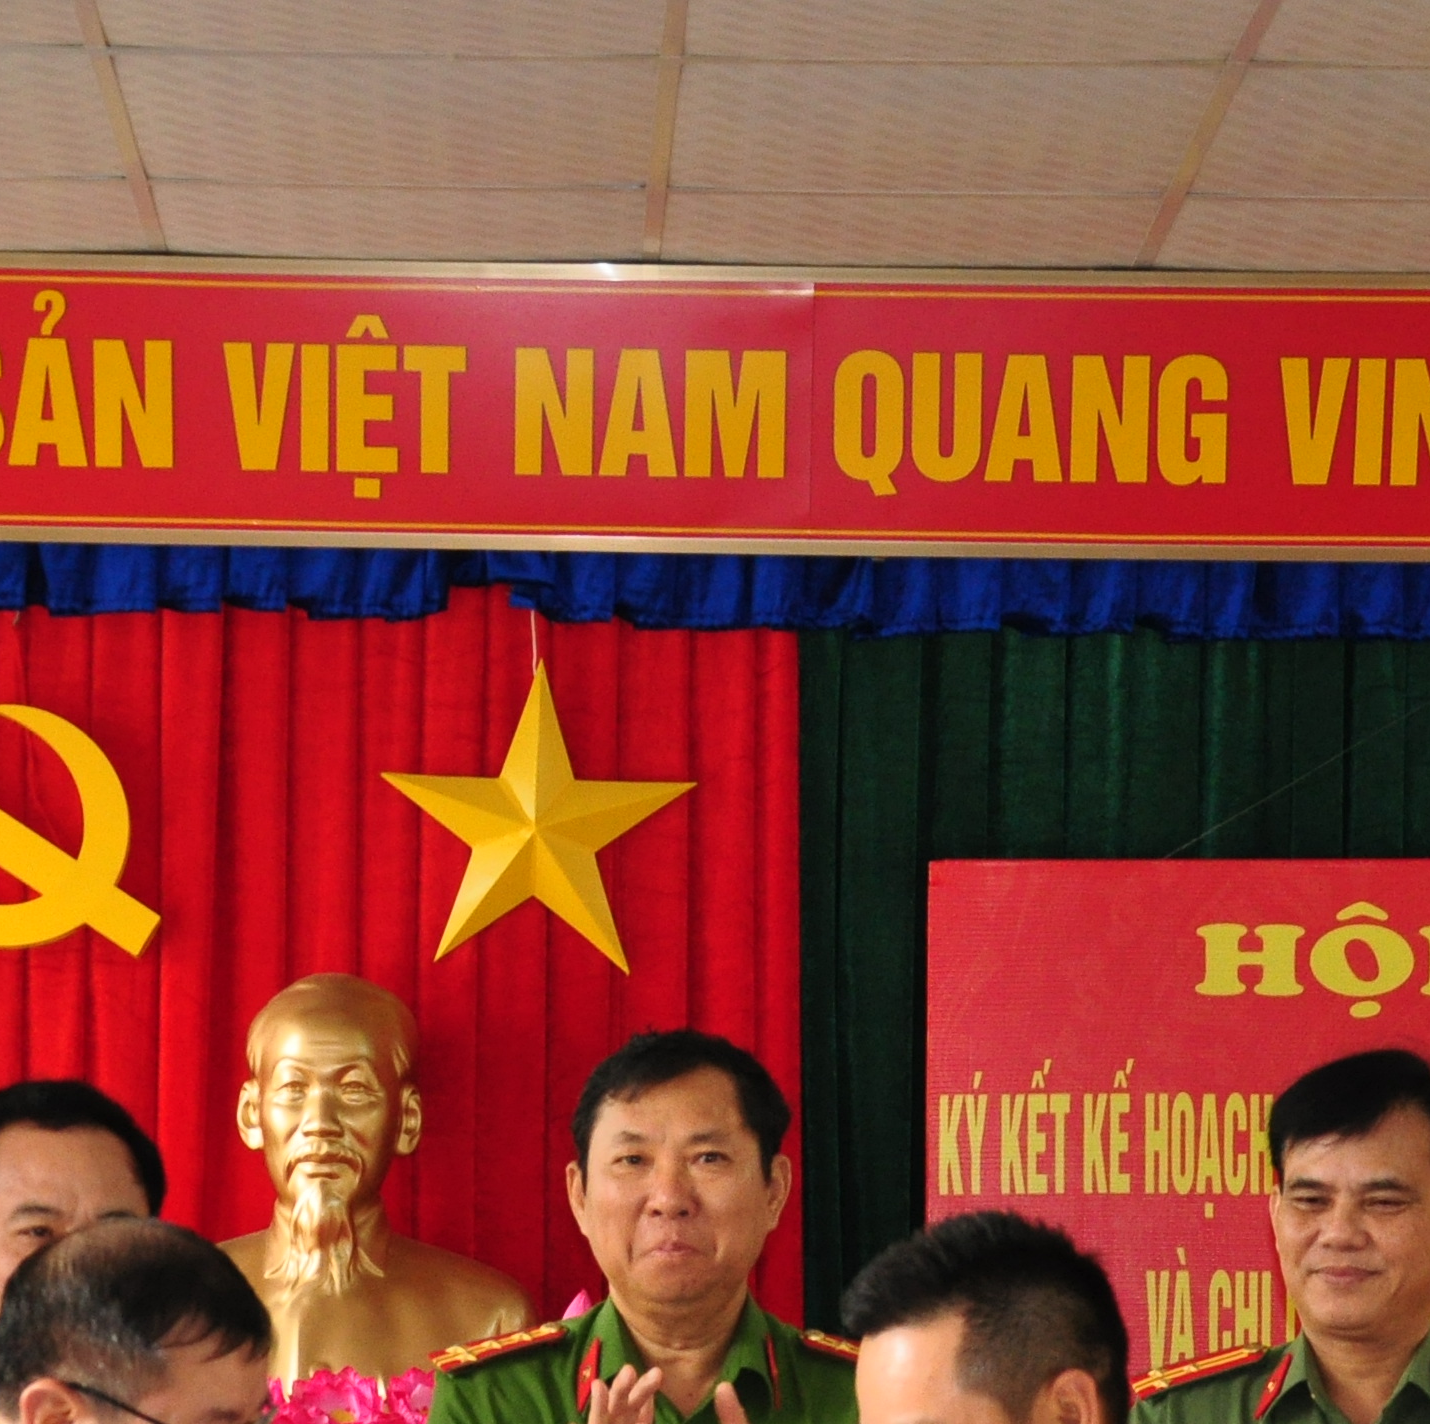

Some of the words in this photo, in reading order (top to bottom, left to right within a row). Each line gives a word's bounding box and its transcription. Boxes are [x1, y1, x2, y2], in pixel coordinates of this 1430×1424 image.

[223, 315, 467, 498] VIỆT
[514, 347, 787, 479] NAM
[833, 349, 1228, 496] QUANG
[937, 1072, 988, 1195] KÝ
[999, 1060, 1070, 1195] KẾT
[1082, 1060, 1133, 1195] KẾ
[1144, 1092, 1273, 1218] HOẠCH
[1146, 1247, 1195, 1369] VÀ
[1208, 1269, 1272, 1352] CHI
